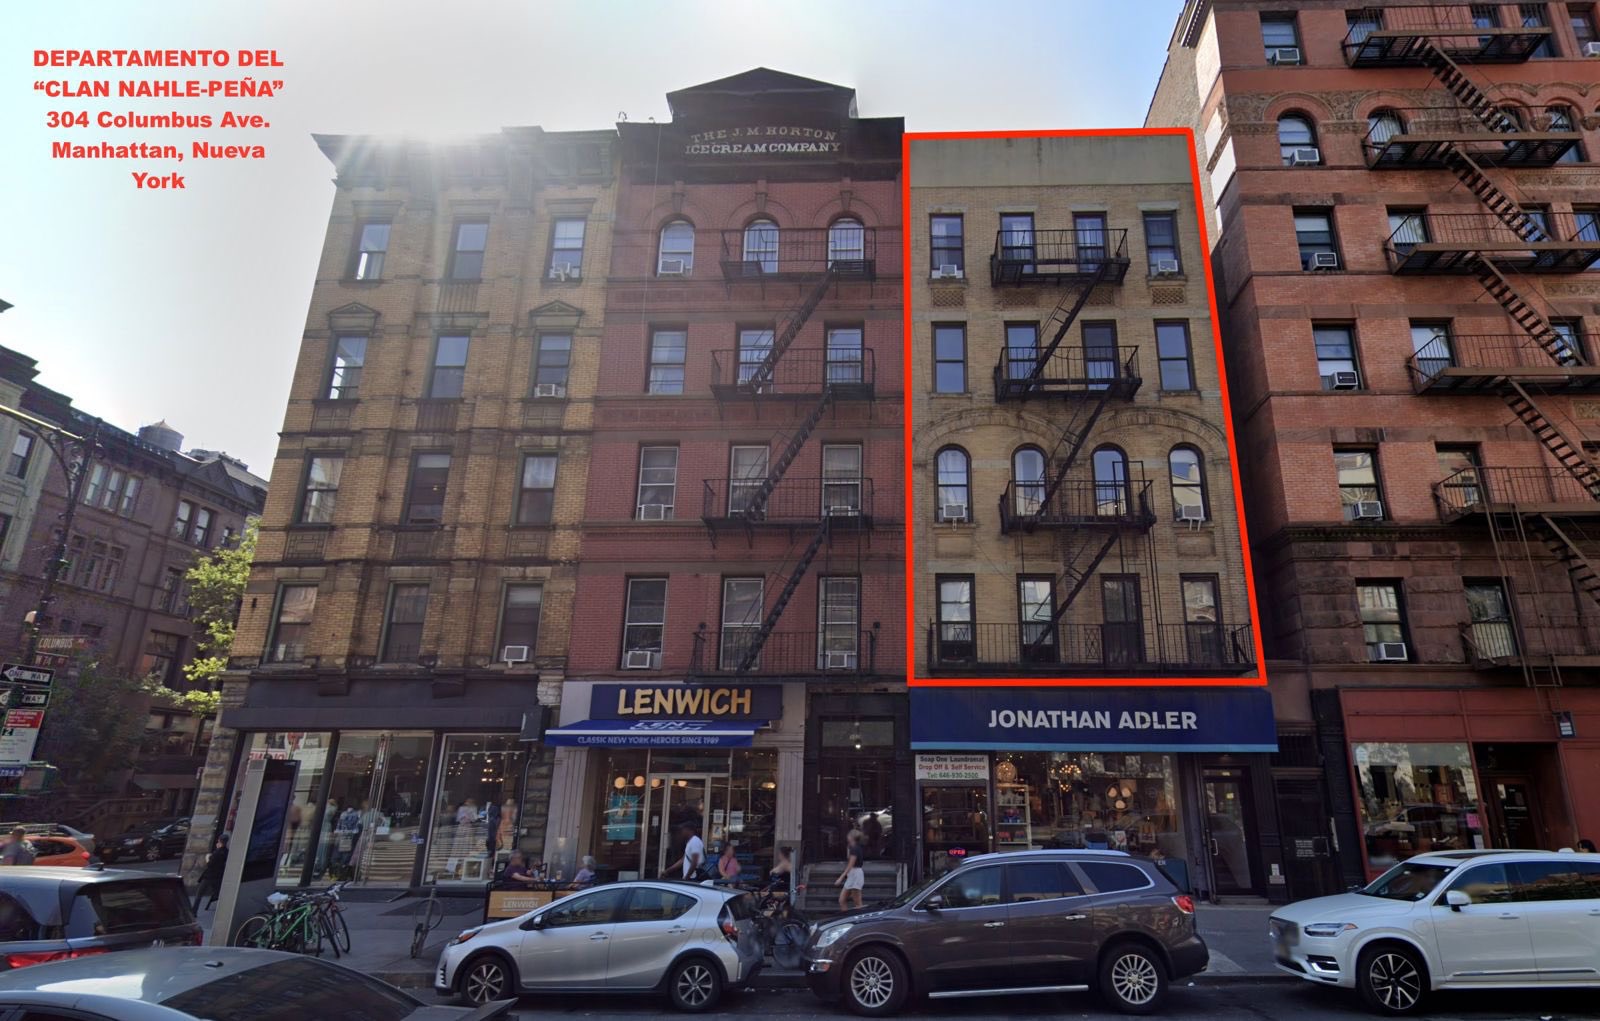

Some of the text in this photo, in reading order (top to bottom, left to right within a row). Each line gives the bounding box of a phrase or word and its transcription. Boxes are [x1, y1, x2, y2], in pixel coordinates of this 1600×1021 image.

[691, 130, 727, 143] THE
[766, 126, 837, 141] HORTON
[685, 142, 841, 154] ICE CREAM COMPANY
[38, 638, 73, 649] COLUMBUS
[9, 669, 48, 681] ONE WAY
[25, 695, 43, 703] WAY
[617, 688, 751, 715] LENWICH
[988, 710, 1198, 730] JONATHAN ADLER
[577, 736, 720, 744] CLASSIC NEW YORK HEROES SINCE 1989
